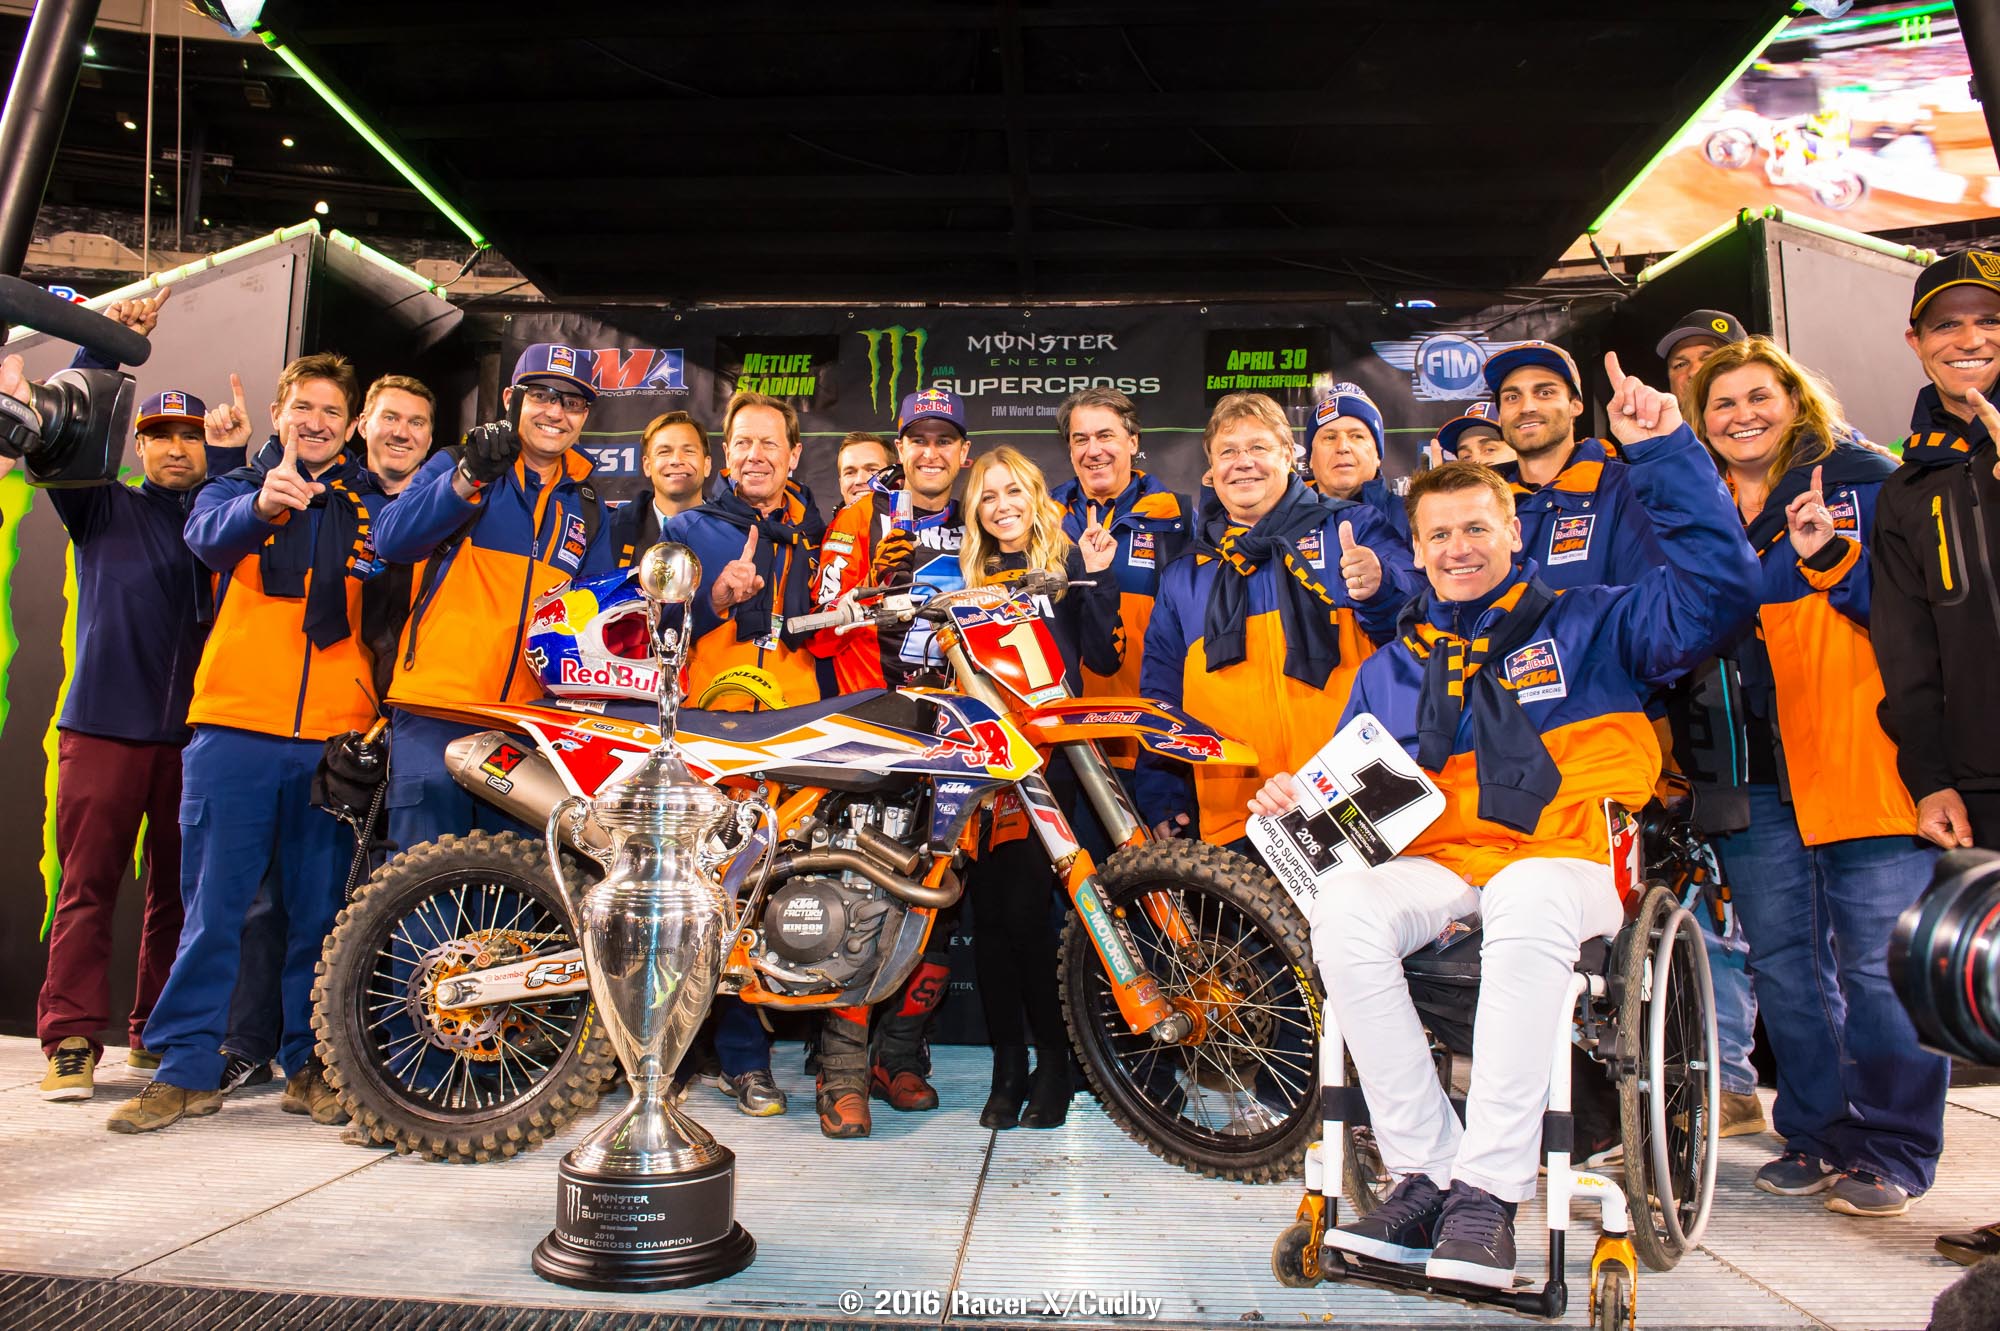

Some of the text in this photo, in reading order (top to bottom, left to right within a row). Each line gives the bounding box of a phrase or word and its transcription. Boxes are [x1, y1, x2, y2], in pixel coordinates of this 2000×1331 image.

[967, 331, 1119, 354] MONSTER
[575, 348, 690, 390] MA
[743, 353, 812, 374] METLIFE
[990, 356, 1096, 367] ENERGY
[1226, 348, 1308, 371] APRIL 30
[1427, 353, 1478, 379] FIM
[932, 366, 956, 377] AMA
[735, 374, 816, 397] STADIUM
[932, 375, 1161, 396] SUPERCROSS
[1206, 375, 1236, 390] EAST
[914, 401, 953, 415] Red Bull
[991, 405, 1059, 417] FIM World Cham
[1553, 539, 1586, 553] KTM
[998, 621, 1055, 690] 1
[1511, 654, 1555, 678] Red Bull
[560, 659, 660, 694] Red Bul
[714, 670, 773, 691] DUNLOP
[1516, 669, 1558, 690] KTM
[592, 723, 615, 732] 450
[1082, 712, 1143, 724] Red Bull
[939, 782, 972, 794] KTM
[1307, 769, 1339, 803] AMA
[1257, 815, 1284, 849] WORLD
[1296, 827, 1322, 856] 2016
[1265, 846, 1304, 897] CHAMPION
[783, 909, 824, 917] FACTORY
[788, 898, 820, 909] KTM
[1090, 911, 1133, 981] MOTOREX
[494, 970, 524, 981] brembo
[577, 1001, 595, 1055] NLOP
[592, 1193, 650, 1205] MONSTER
[581, 1211, 666, 1222] SUPERCROSS
[569, 1235, 633, 1249] SUPERCROSS
[635, 1236, 693, 1249] CHAMPION
